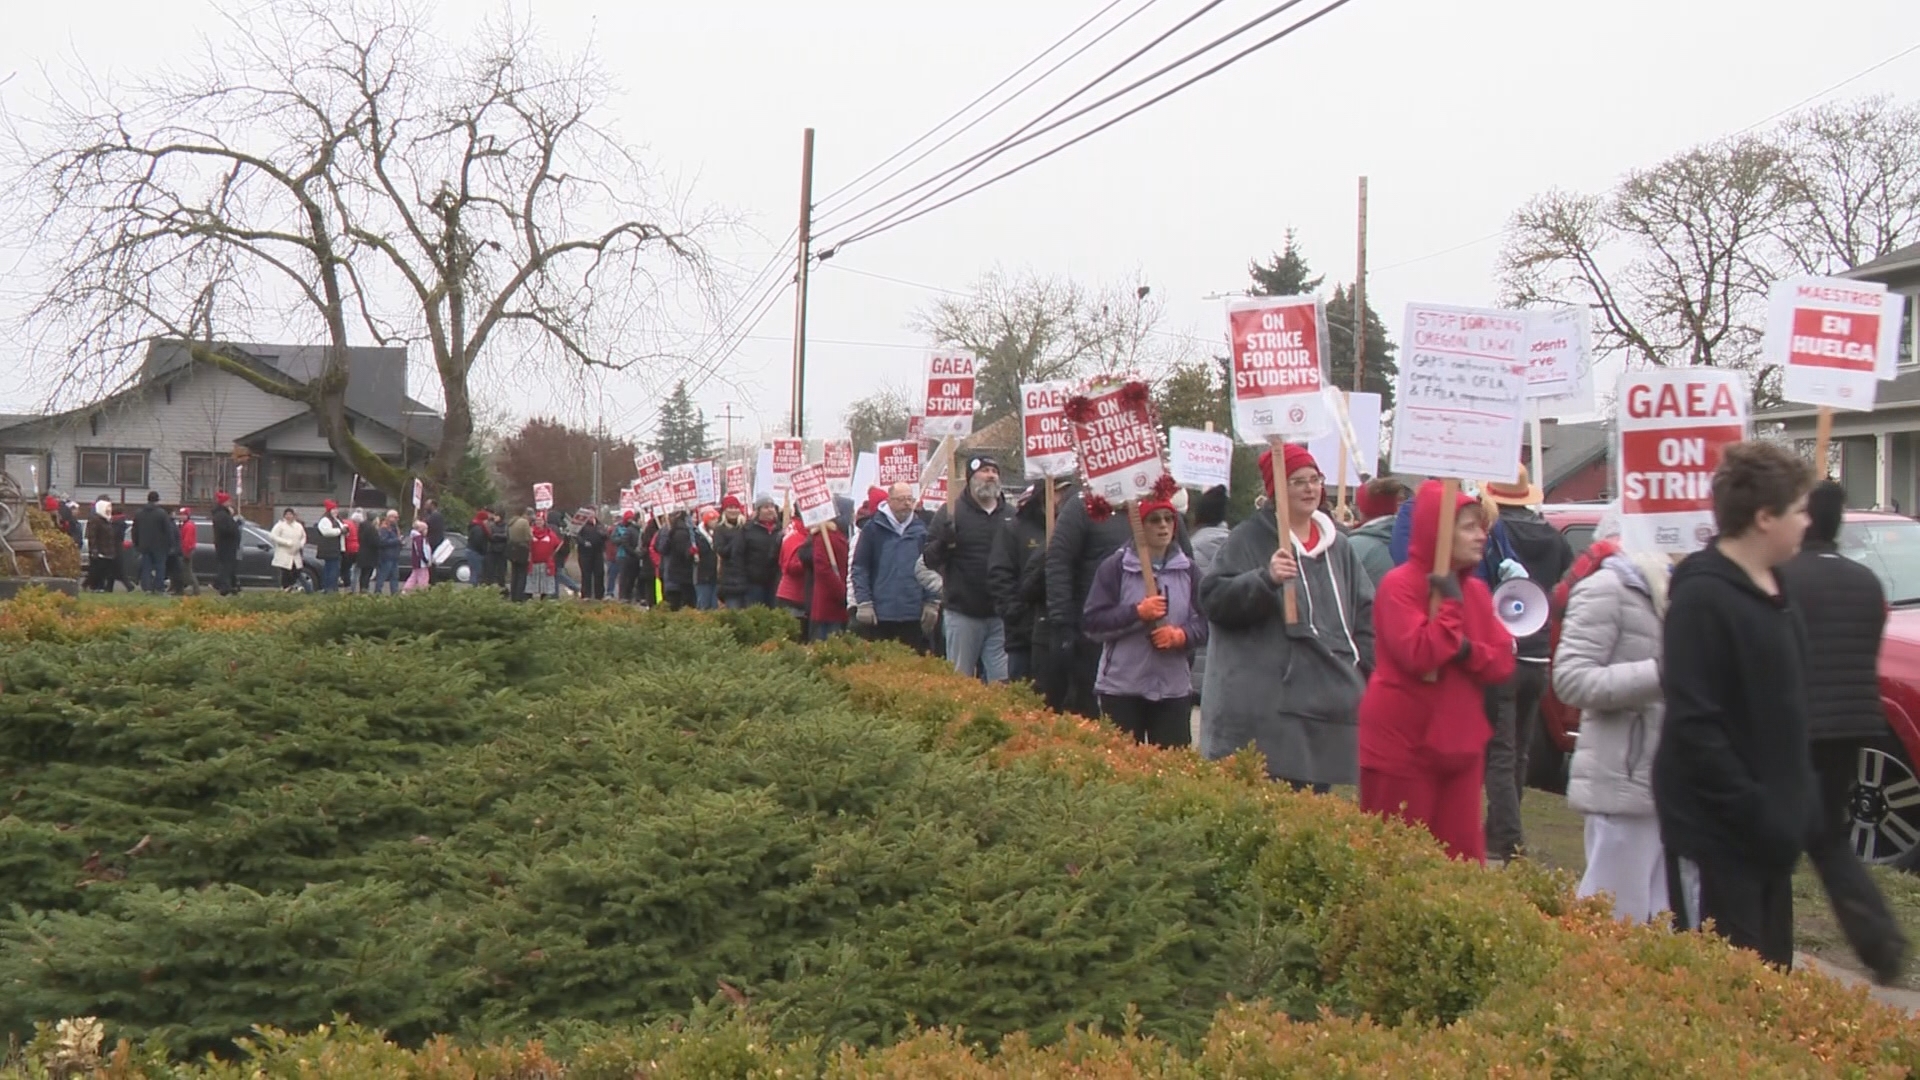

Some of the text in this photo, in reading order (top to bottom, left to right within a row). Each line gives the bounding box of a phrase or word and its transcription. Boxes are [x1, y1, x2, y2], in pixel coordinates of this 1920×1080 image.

[1797, 286, 1882, 307] MAESTROS
[1262, 313, 1284, 330] ON
[1416, 312, 1456, 327] STOP
[1821, 315, 1851, 335] EN
[1246, 331, 1303, 349] STRIKE
[1415, 330, 1468, 347] OREGON
[1791, 335, 1874, 362] HUELGA
[932, 358, 973, 374] GAEA
[1242, 350, 1310, 369] FOR OUR
[1236, 367, 1319, 388] STUDENTS
[942, 383, 960, 396] ON
[928, 397, 973, 411] STRIKE
[1027, 390, 1066, 409] GAE
[1097, 398, 1120, 416] ON
[1627, 383, 1738, 419] GAEA
[1041, 417, 1060, 432] ON
[1085, 410, 1139, 437] STRIKE
[1080, 424, 1150, 456] FOR SAFE
[884, 455, 913, 465] STRIKE
[892, 447, 904, 455] ON
[1086, 441, 1154, 471] SCHOOLS
[1658, 437, 1705, 467] ON
[881, 464, 918, 474] FOR SAFE
[881, 472, 917, 482] SCHOOLS
[1625, 471, 1715, 500] STRIK
